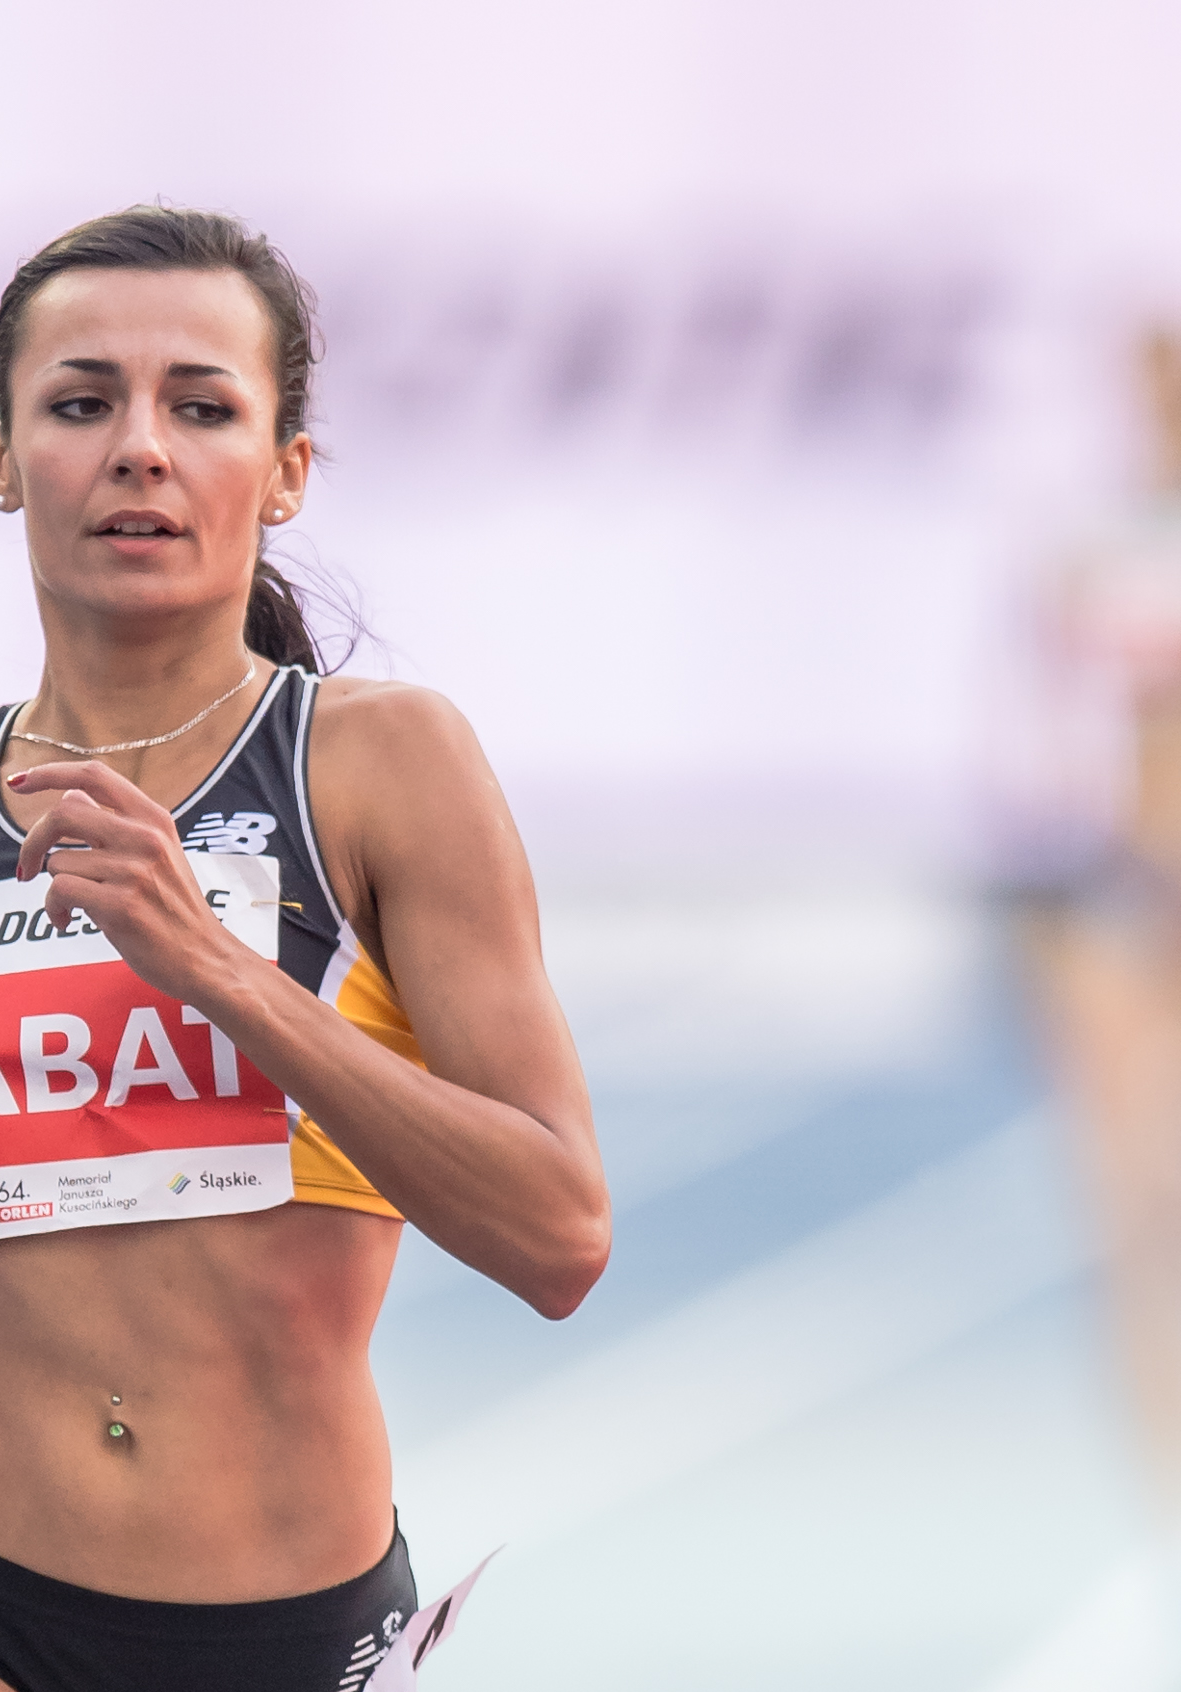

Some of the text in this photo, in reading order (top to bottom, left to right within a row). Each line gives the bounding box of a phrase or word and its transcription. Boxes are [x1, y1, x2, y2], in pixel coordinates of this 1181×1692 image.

[57, 1171, 112, 1188] Memoriał
[199, 1170, 262, 1191] Śląskie.
[58, 1189, 104, 1202] Janusza
[0, 1204, 52, 1221] ORLEN
[58, 1195, 138, 1214] Kusocińskiego
